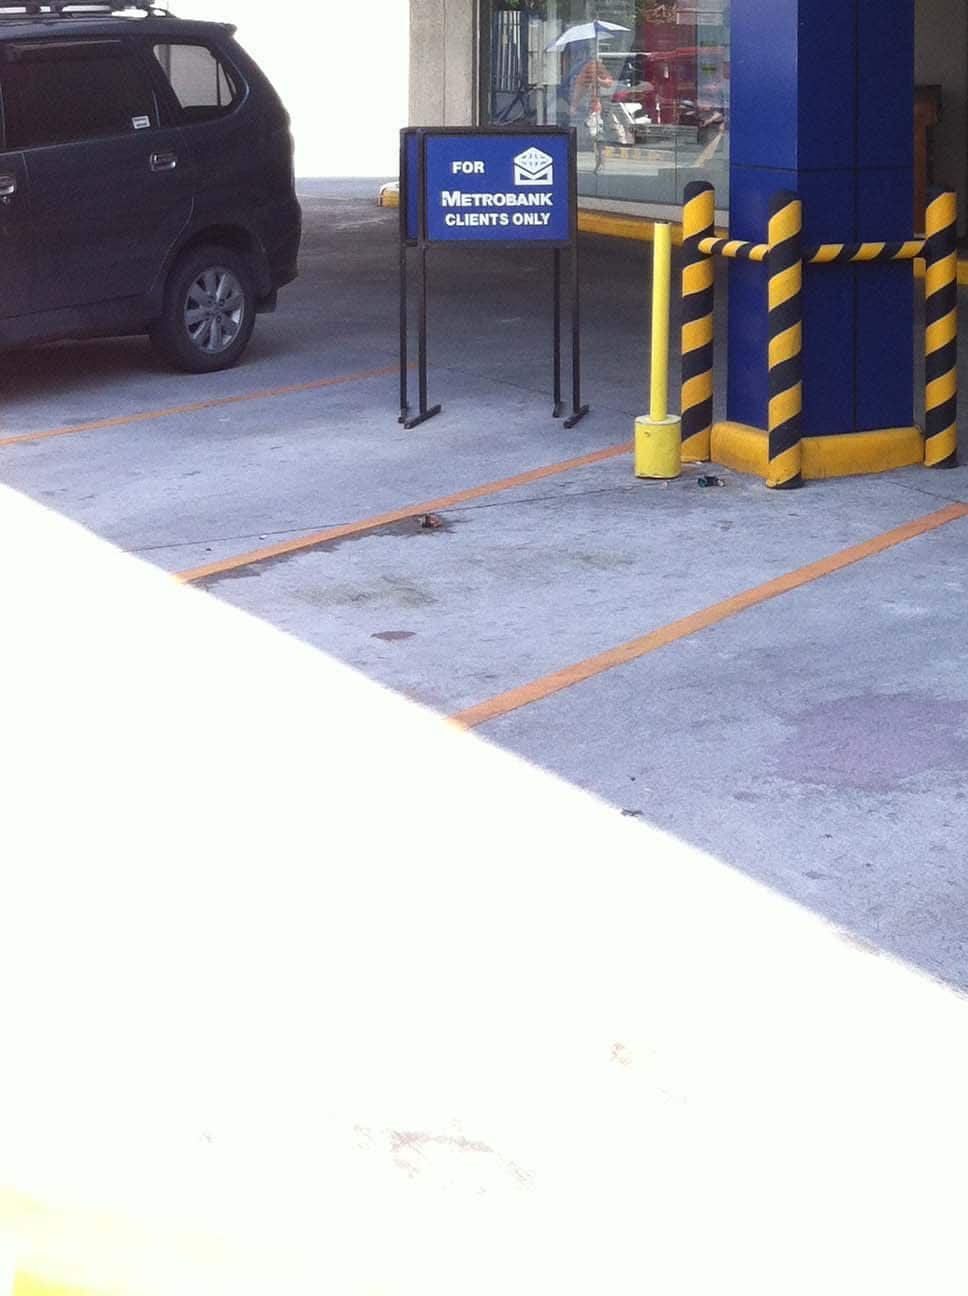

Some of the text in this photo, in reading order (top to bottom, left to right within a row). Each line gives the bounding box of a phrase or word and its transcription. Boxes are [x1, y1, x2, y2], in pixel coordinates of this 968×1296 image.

[452, 161, 485, 174] FOR
[441, 191, 553, 207] METROBANK
[445, 213, 551, 226] CLIENTS ONLY
